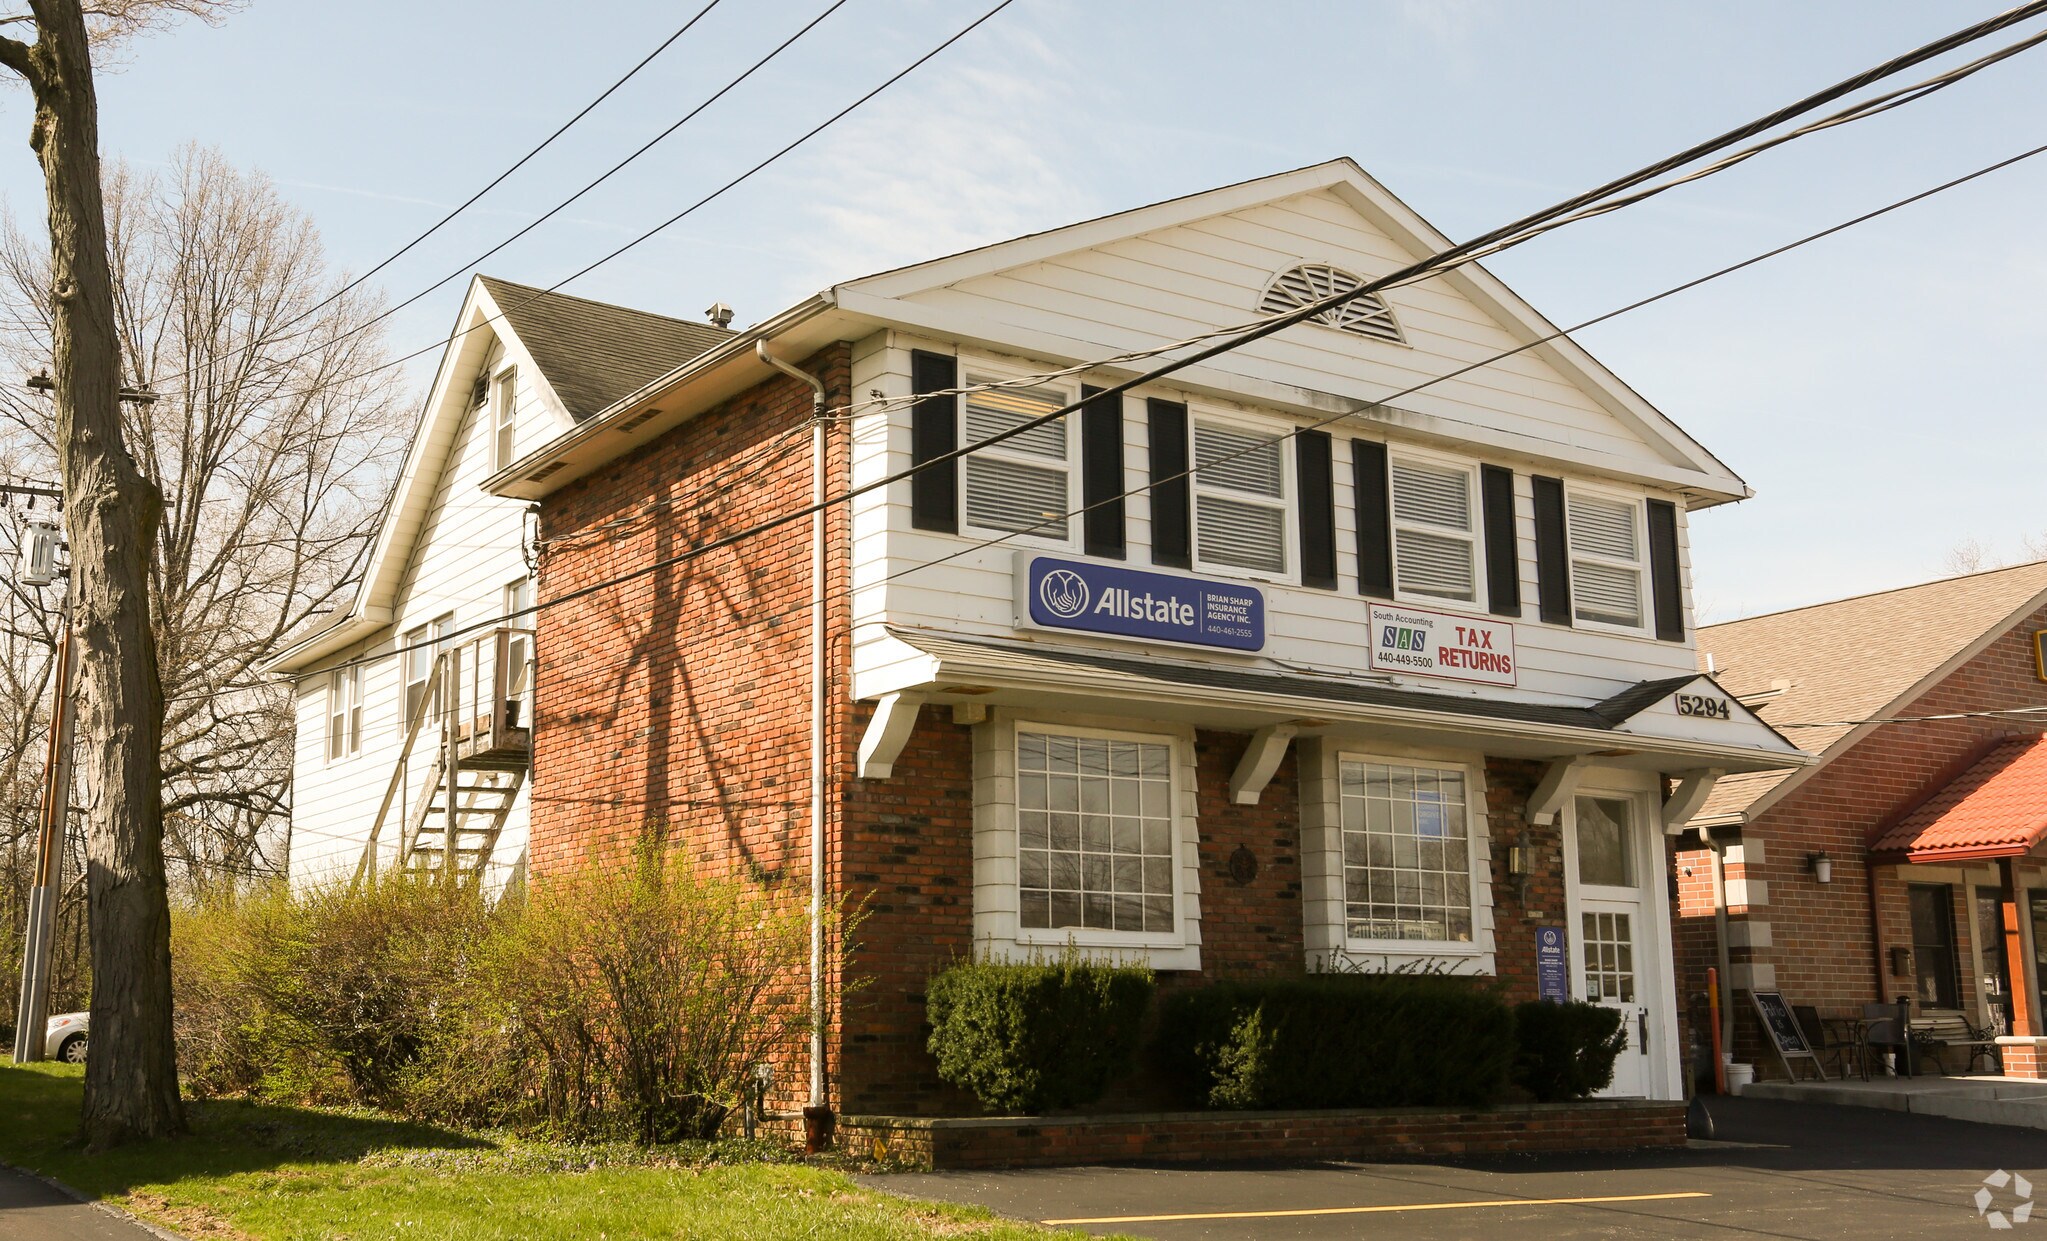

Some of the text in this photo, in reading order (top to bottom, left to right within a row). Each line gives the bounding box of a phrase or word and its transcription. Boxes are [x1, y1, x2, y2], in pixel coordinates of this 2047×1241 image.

[1094, 587, 1195, 626] Allstate
[1207, 593, 1253, 607] BRIAN SHARP
[1207, 602, 1247, 615] INSURANCE
[1207, 611, 1251, 624] AGENCY INC.
[1373, 610, 1434, 628] South Accounting
[1208, 625, 1253, 638] 440-461-2555
[1384, 627, 1424, 651] SAS
[1455, 626, 1492, 649] TAX
[1378, 651, 1433, 668] 440-449-5500
[1438, 646, 1512, 674] RETURNS
[1680, 695, 1730, 719] 5294
[1760, 1001, 1786, 1017] Patio
[1775, 1032, 1800, 1048] Open
